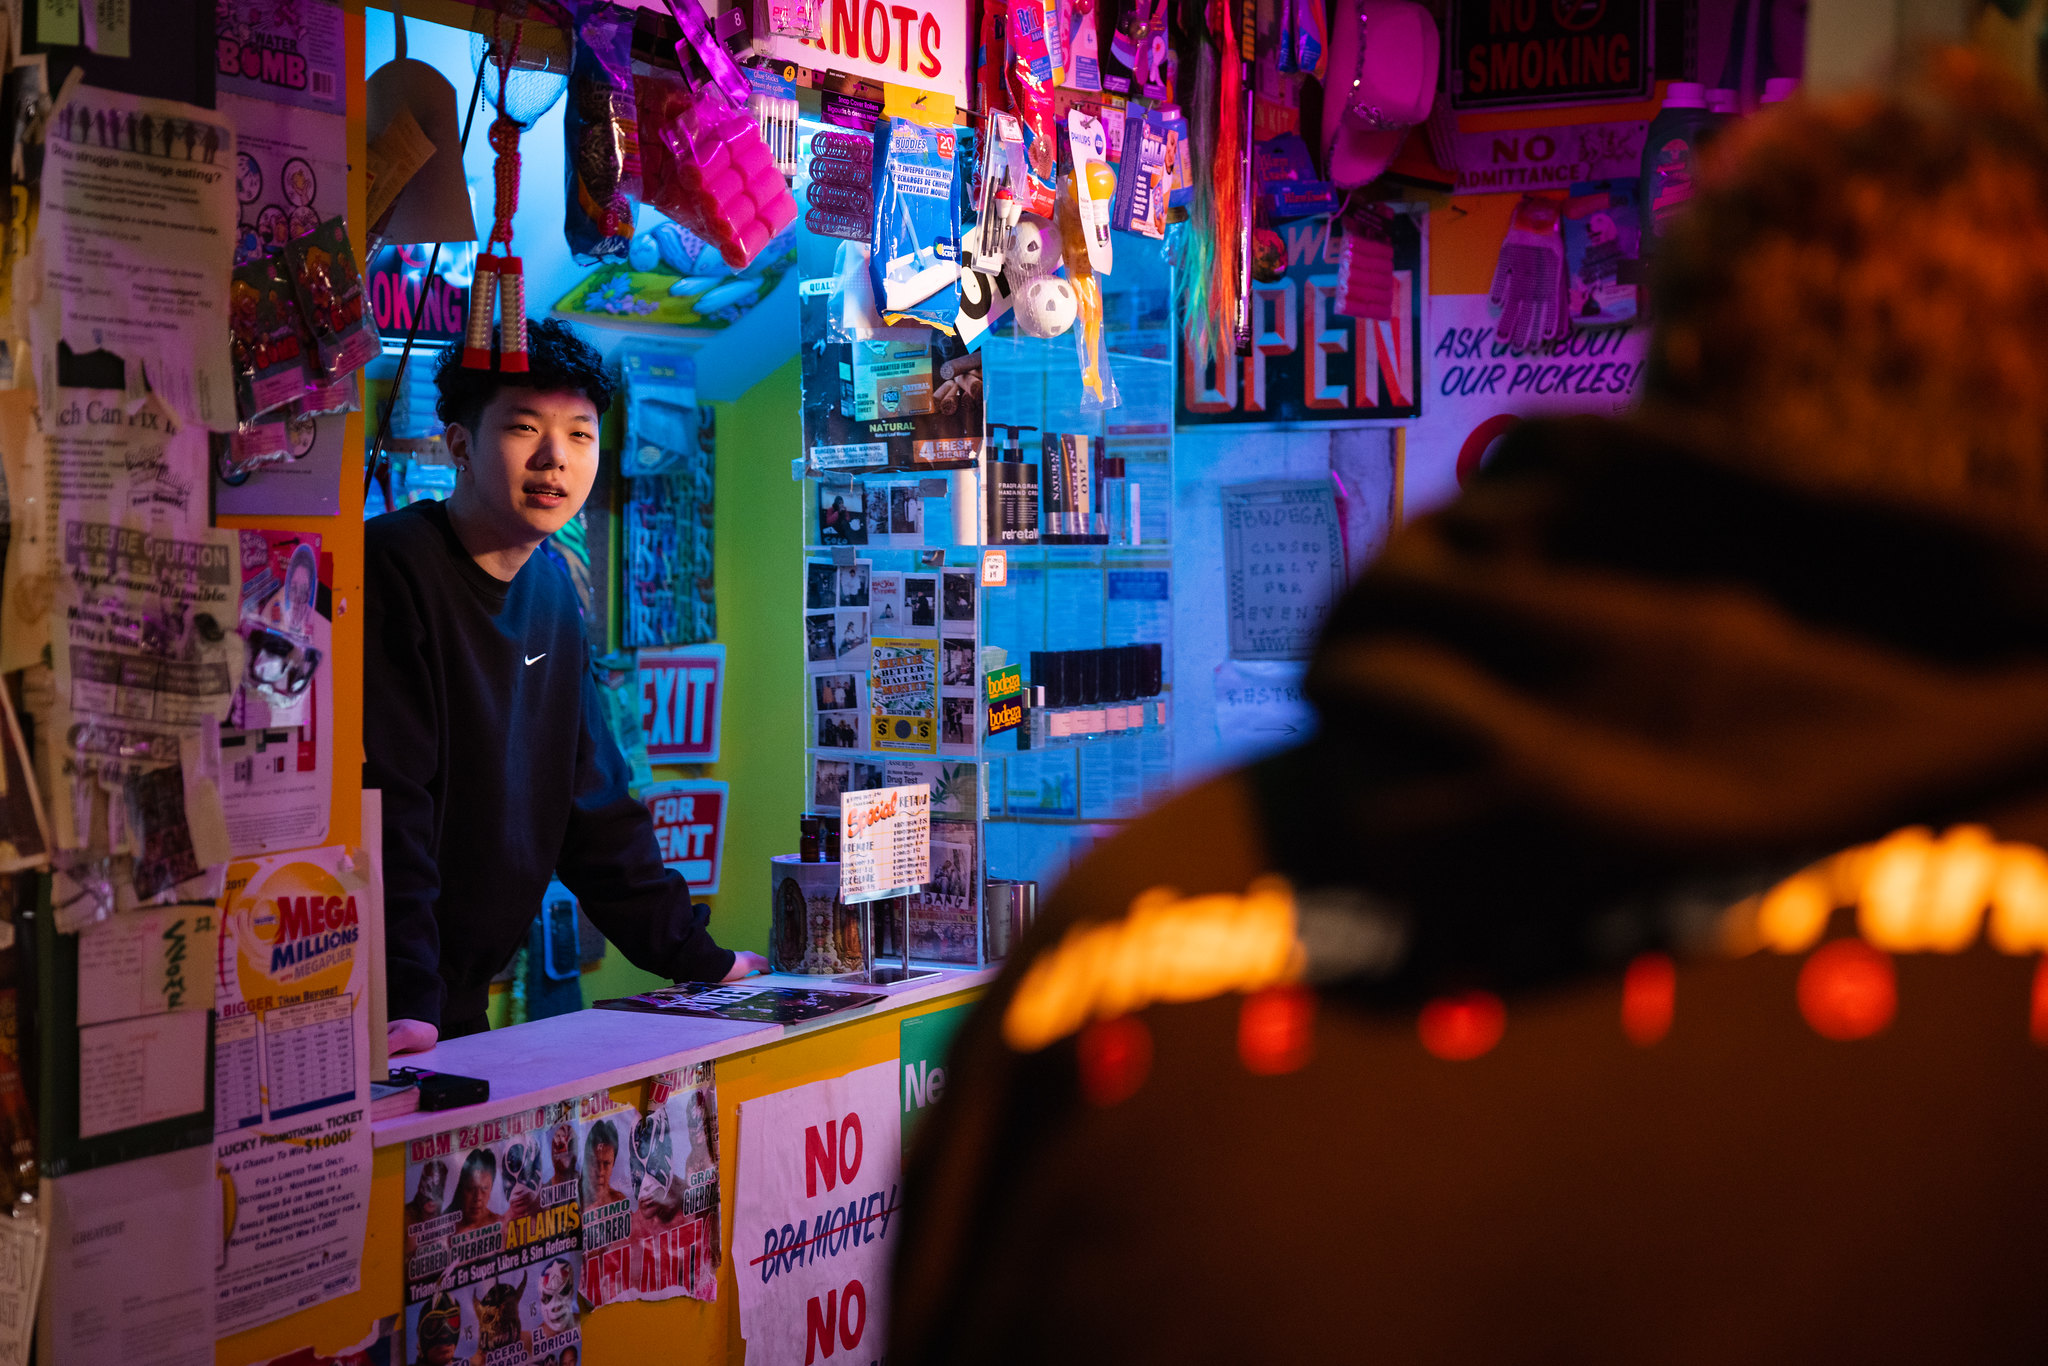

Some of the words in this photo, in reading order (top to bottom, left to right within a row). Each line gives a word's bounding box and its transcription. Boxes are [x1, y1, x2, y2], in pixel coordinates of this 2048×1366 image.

[255, 31, 299, 52] WATER
[216, 37, 307, 90] BOMB
[1468, 32, 1631, 94] SMOKING
[895, 138, 927, 149] BUDDIES
[939, 135, 953, 151] 20
[1491, 137, 1555, 164] NO
[902, 165, 924, 175] SWEEPER
[1456, 163, 1581, 189] ADMITTANCE
[897, 184, 929, 195] NETTOYANTS
[367, 270, 463, 334] OKING
[1435, 326, 1494, 358] ASK
[1537, 325, 1633, 358] BOUT
[1441, 362, 1507, 396] OUR
[1507, 359, 1645, 395] PICKLES!
[88, 400, 124, 426] Can
[869, 421, 916, 433] NATURAL
[918, 440, 934, 460] 4
[936, 438, 973, 450] FRESH
[1242, 507, 1326, 527] BODEGA
[1249, 560, 1318, 577] EARLY
[881, 664, 925, 678] BETTER
[987, 671, 1021, 696] bodega
[640, 666, 715, 747] EXIT
[988, 703, 1023, 729] bodega
[887, 775, 904, 785] Drug
[904, 776, 919, 785] Test
[653, 796, 696, 824] FOR
[656, 825, 714, 862] ENT
[275, 896, 359, 945] MEGA
[271, 927, 359, 974] MILLIONS
[294, 950, 352, 981] MEGAPLIER
[223, 996, 274, 1018] BIGGER
[905, 1059, 948, 1113] Ne
[218, 1139, 256, 1158] LUCKY
[326, 1111, 363, 1130] TICKET
[411, 1133, 452, 1162] DOM
[459, 1126, 480, 1150] 23
[483, 1121, 503, 1143] DE
[805, 1112, 863, 1199] NO
[541, 1187, 554, 1206] SIN
[267, 1210, 290, 1224] MEGA
[506, 1202, 581, 1249] ATLANTIS
[761, 1219, 808, 1284] BRA
[809, 1184, 898, 1265] MONEY
[450, 1232, 502, 1265] GUERRERO
[457, 1271, 469, 1286] En
[470, 1261, 495, 1283] Super
[497, 1253, 519, 1275] Libre
[529, 1244, 544, 1260] Sin
[532, 1328, 545, 1343] EL
[804, 1280, 866, 1366] NO
[486, 1342, 524, 1364] ACERO
[533, 1331, 580, 1356] BORICUA
